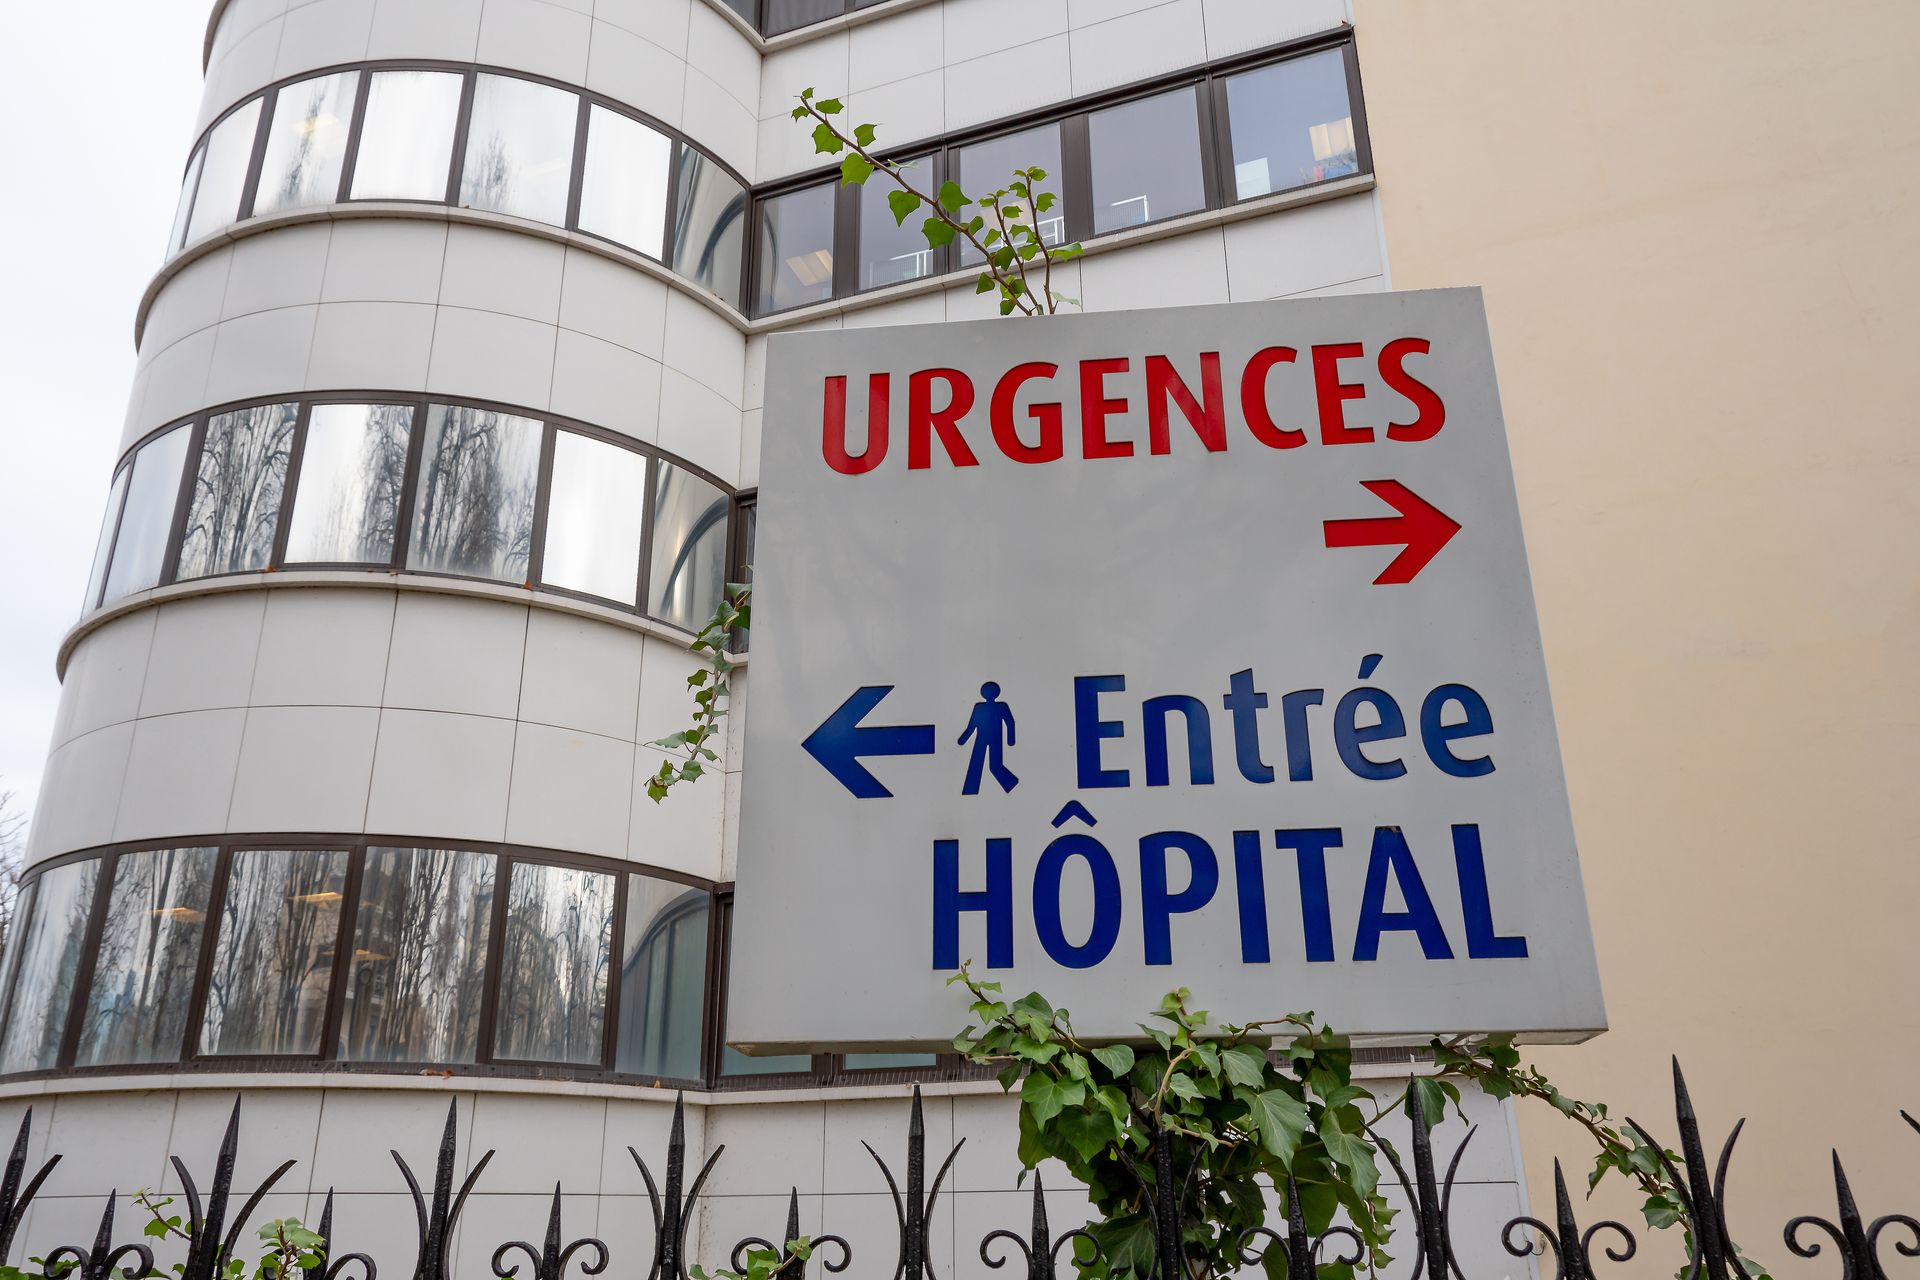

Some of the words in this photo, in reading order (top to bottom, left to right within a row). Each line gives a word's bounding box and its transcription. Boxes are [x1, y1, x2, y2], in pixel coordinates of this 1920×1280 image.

[822, 338, 1446, 476] URGENCES
[1074, 654, 1496, 789] Entrée
[932, 801, 1529, 970] HÔPITAL
